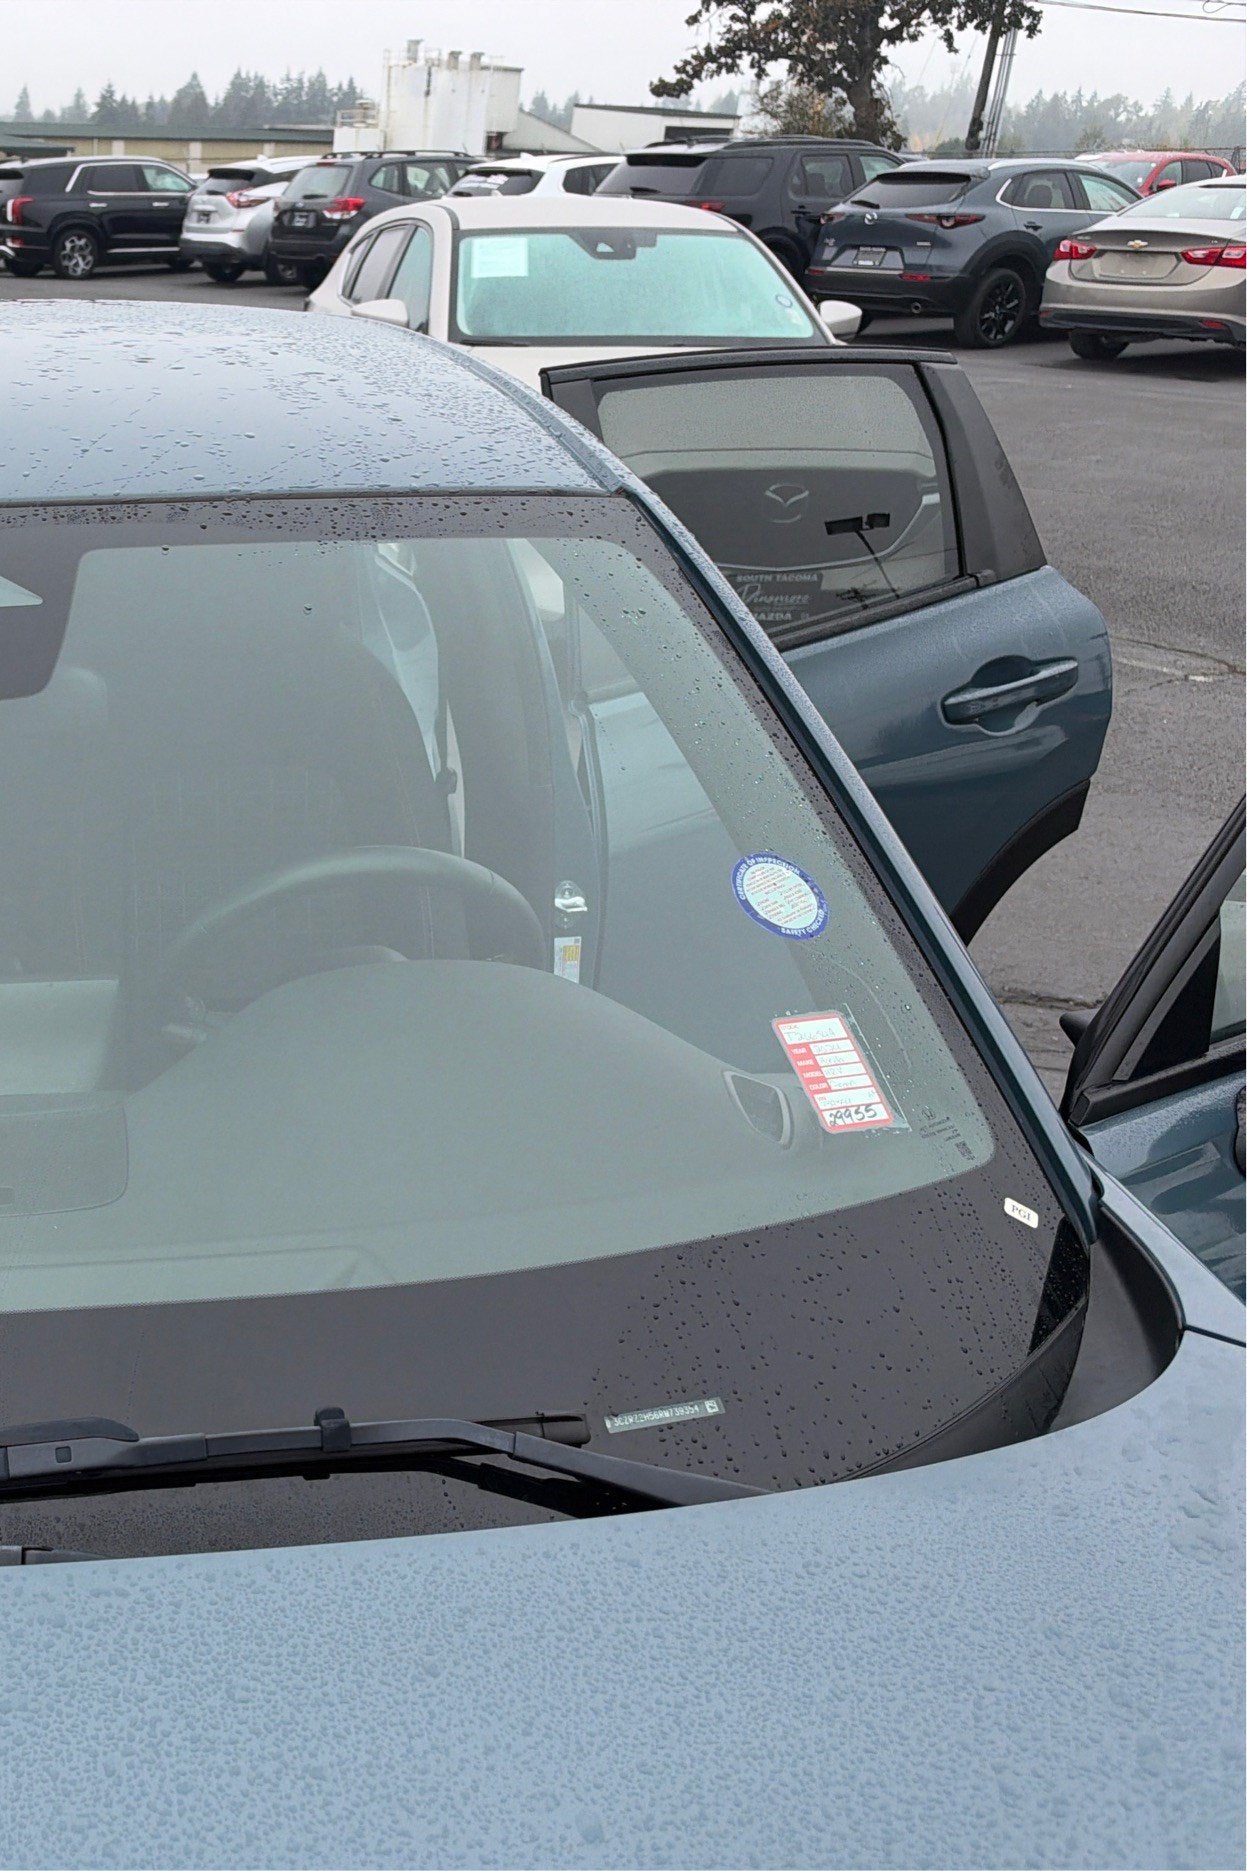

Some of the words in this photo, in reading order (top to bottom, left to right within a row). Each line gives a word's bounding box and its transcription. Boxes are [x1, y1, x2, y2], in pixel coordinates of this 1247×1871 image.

[736, 573, 772, 583] SOUTH
[775, 573, 818, 583] TACOMA
[756, 857, 800, 875] INSPECTION
[780, 927, 807, 937] SAFETY
[1011, 1204, 1032, 1221] PGI
